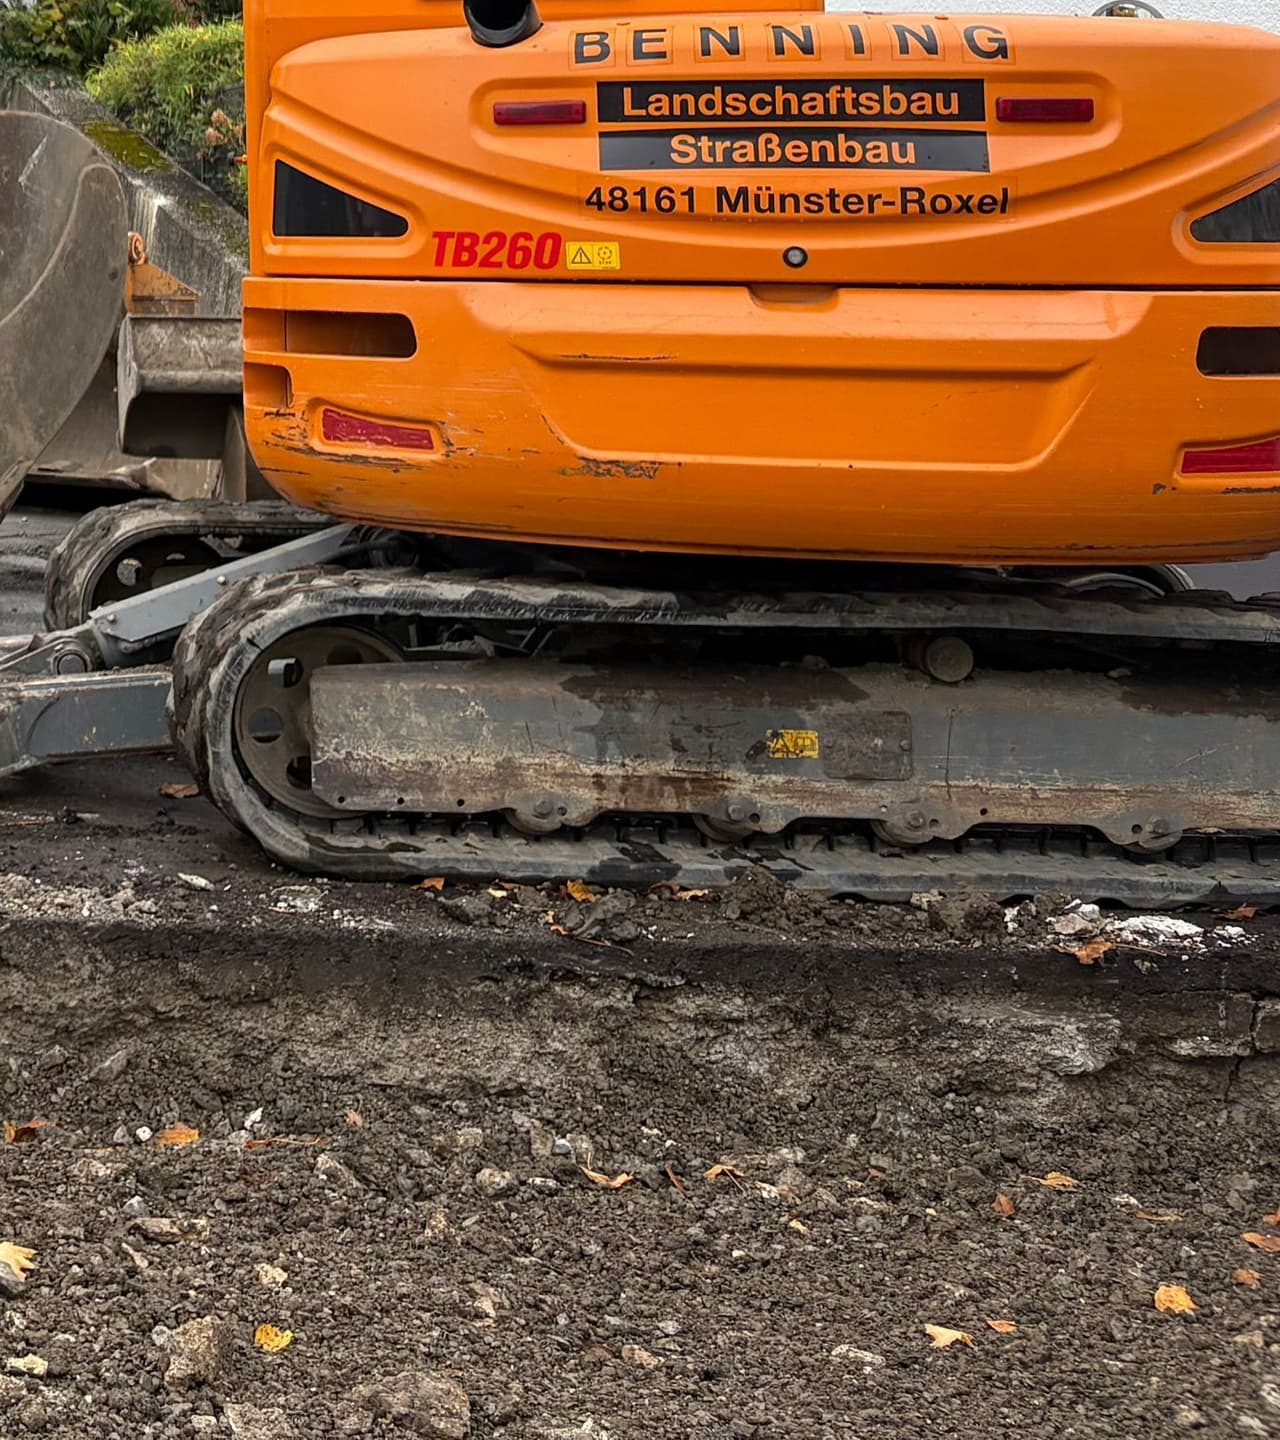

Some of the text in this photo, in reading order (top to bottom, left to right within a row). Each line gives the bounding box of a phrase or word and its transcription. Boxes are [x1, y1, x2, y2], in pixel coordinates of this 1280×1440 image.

[572, 23, 1010, 65] BENNING
[622, 84, 960, 118] Landschaftsbau
[669, 132, 917, 165] Straßenbau
[584, 184, 1010, 216] 48161 Münster-Roxel
[431, 230, 563, 270] TB260
